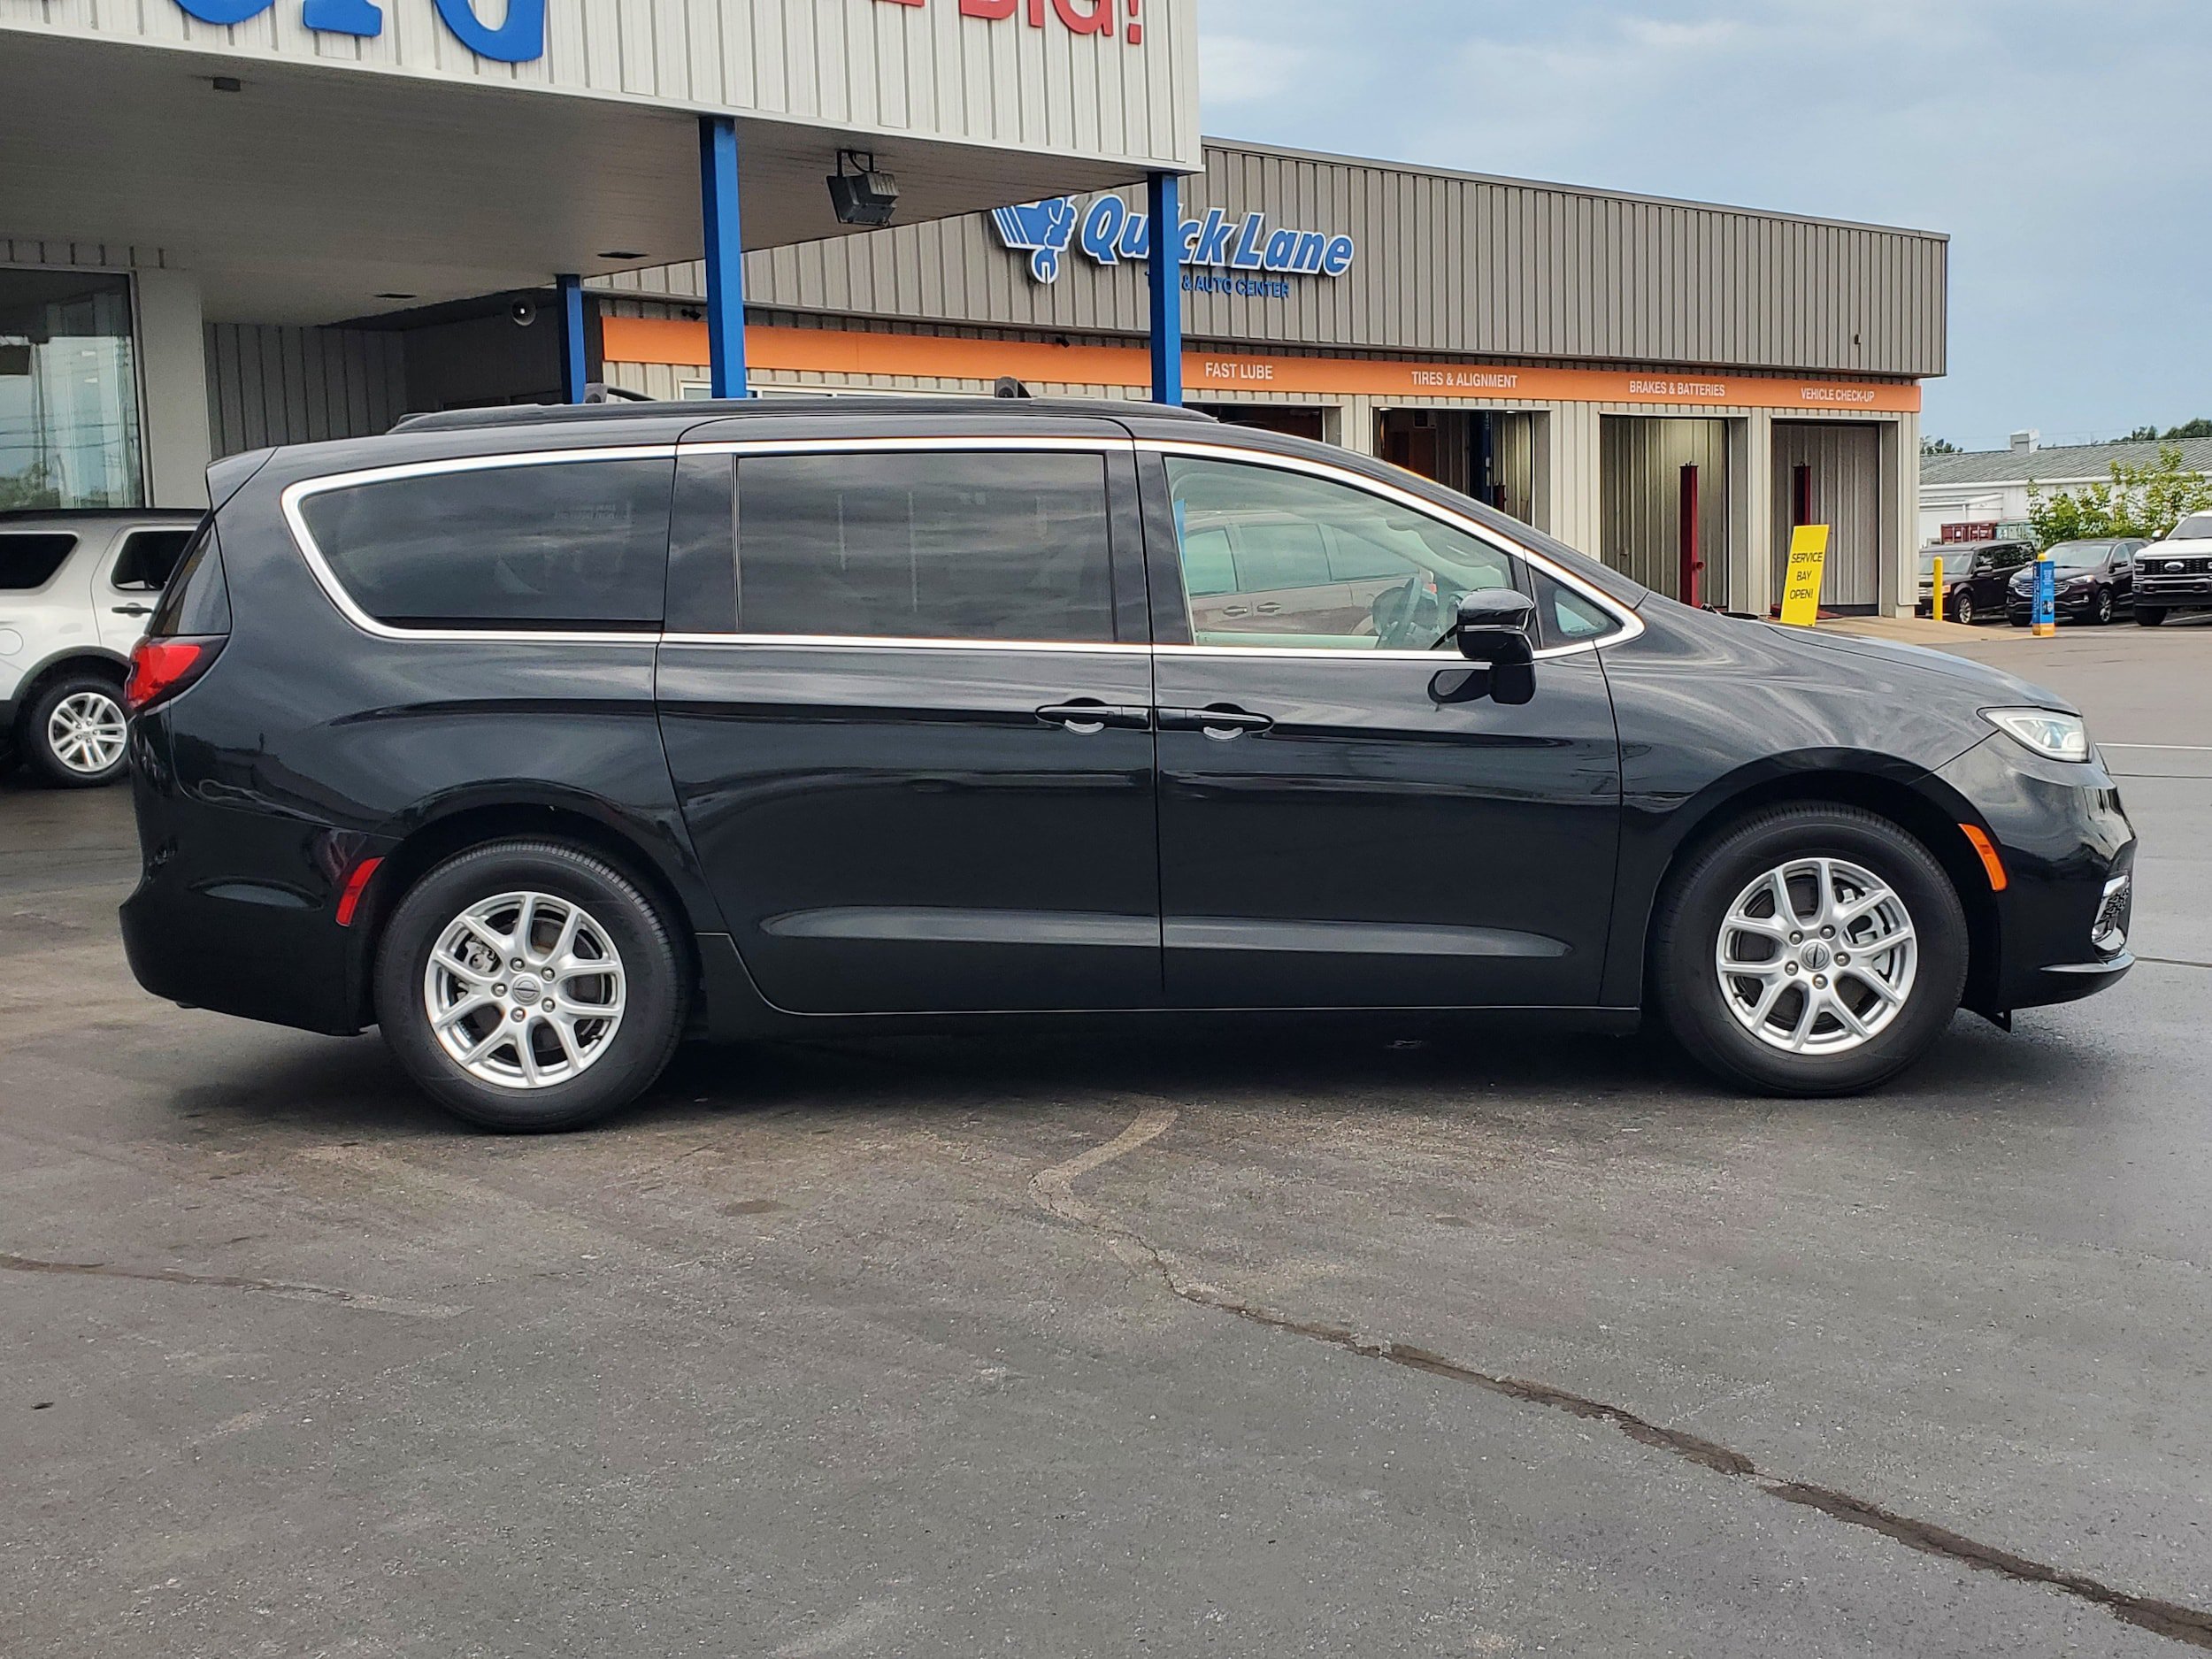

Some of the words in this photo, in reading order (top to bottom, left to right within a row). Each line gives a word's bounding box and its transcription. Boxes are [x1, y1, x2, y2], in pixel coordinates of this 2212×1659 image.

[1082, 194, 1237, 265] Quck
[1232, 211, 1354, 277] Lane
[1182, 275, 1193, 292] &
[1194, 277, 1233, 294] AUTO
[1236, 280, 1289, 298] CENTER
[1205, 362, 1237, 378] FAST
[1240, 365, 1273, 379] LUBE
[1412, 372, 1444, 386] TIRES
[1447, 373, 1454, 386] &
[1455, 373, 1517, 388] ALIGNMENT
[1629, 380, 1667, 395] BRAKES
[1669, 383, 1675, 395] &
[1678, 383, 1724, 396] BATTERIES
[1801, 388, 1834, 401] VEHICLE
[1835, 388, 1875, 403] CHECK-UP
[1791, 552, 1823, 564] SERVICE
[1796, 571, 1812, 581] BAY
[1790, 588, 1813, 599] OPEN!
